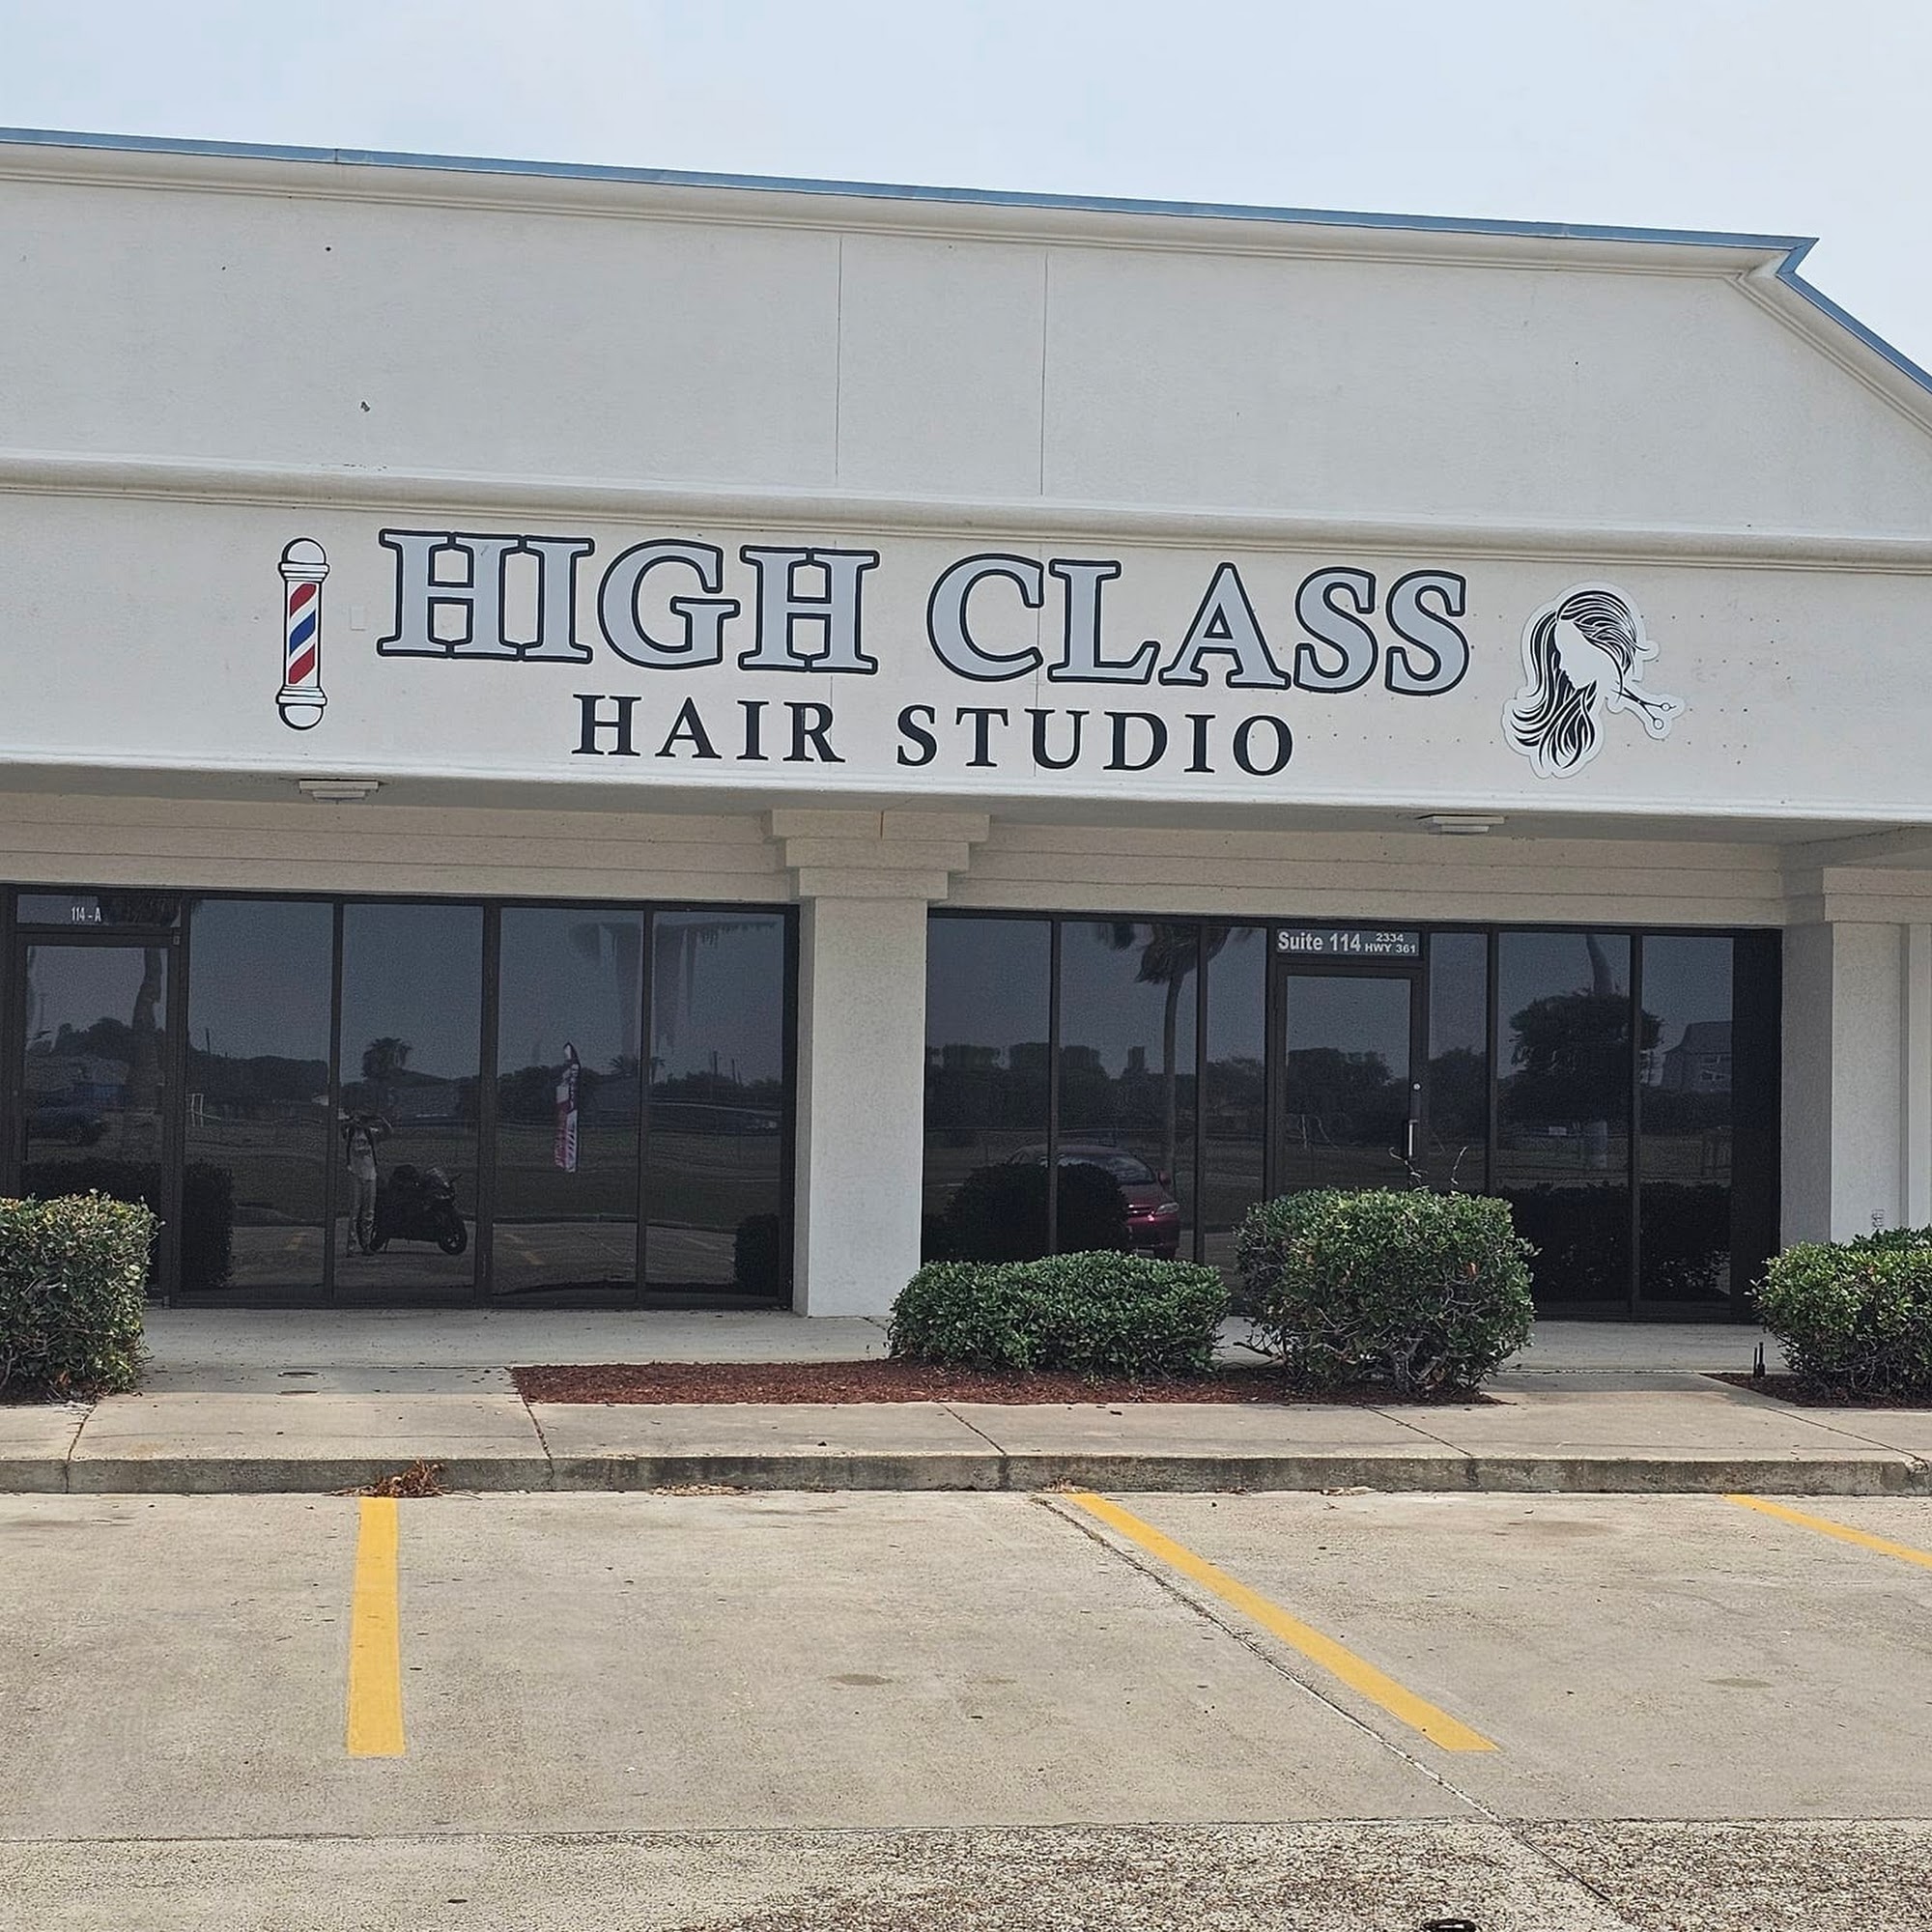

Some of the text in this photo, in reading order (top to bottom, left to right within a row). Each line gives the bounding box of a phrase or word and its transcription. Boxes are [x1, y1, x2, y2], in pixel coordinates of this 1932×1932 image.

[378, 528, 1470, 696] HIGH CLASS
[571, 694, 1293, 776] HAIR STUDIO
[1277, 931, 1361, 952] Suite 114
[1376, 932, 1405, 943] 2334
[1364, 943, 1416, 954] HWY 361
